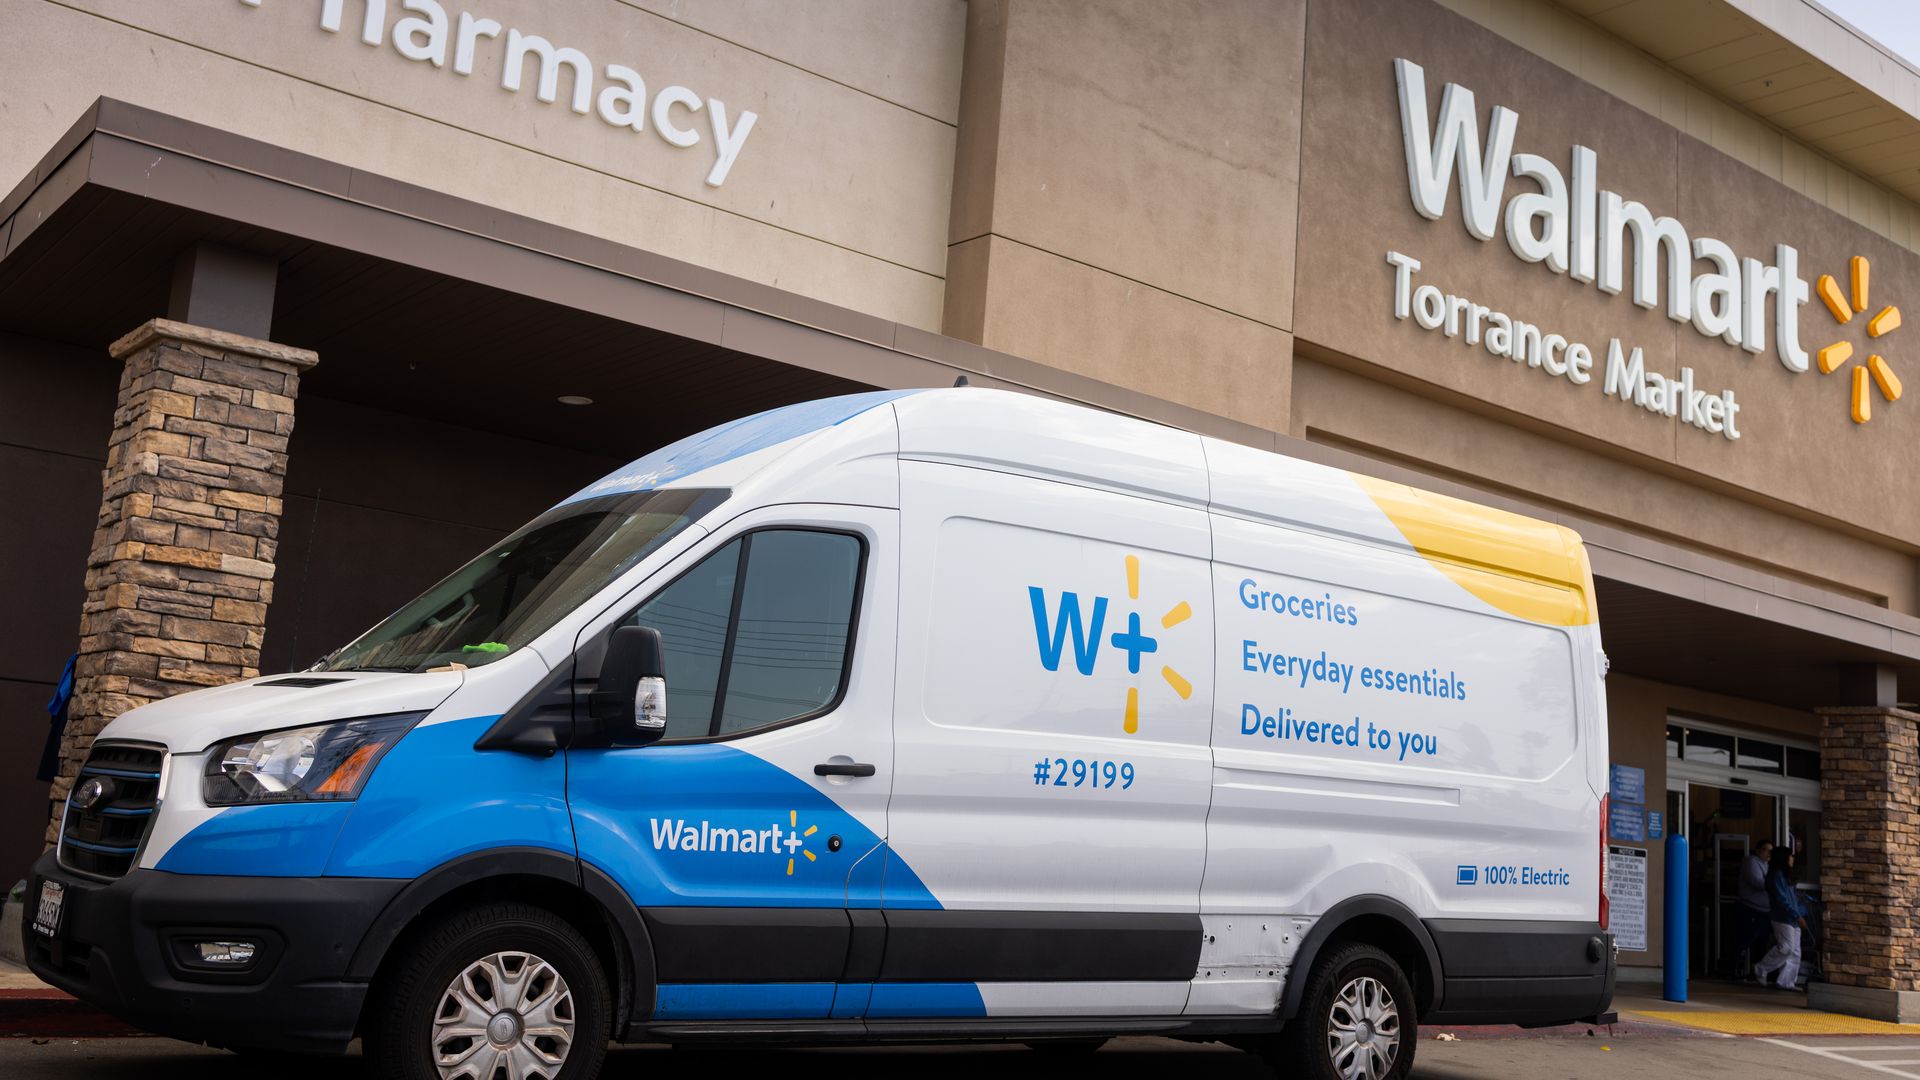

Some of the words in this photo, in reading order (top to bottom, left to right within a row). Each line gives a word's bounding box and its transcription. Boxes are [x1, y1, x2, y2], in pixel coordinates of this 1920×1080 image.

[239, 0, 758, 187] armacy
[1394, 58, 1809, 373] Walmart
[1386, 251, 1593, 385] Torrance
[1604, 338, 1741, 440] Market
[1239, 578, 1358, 626] Groceries
[1243, 639, 1354, 693] Everyday
[1360, 669, 1466, 701] essentials
[1240, 703, 1359, 747] Delivered
[1368, 723, 1391, 751] to
[1399, 730, 1437, 760] you
[1033, 757, 1135, 790] #29199
[1484, 866, 1518, 885] 100%
[1521, 867, 1570, 886] Electric
